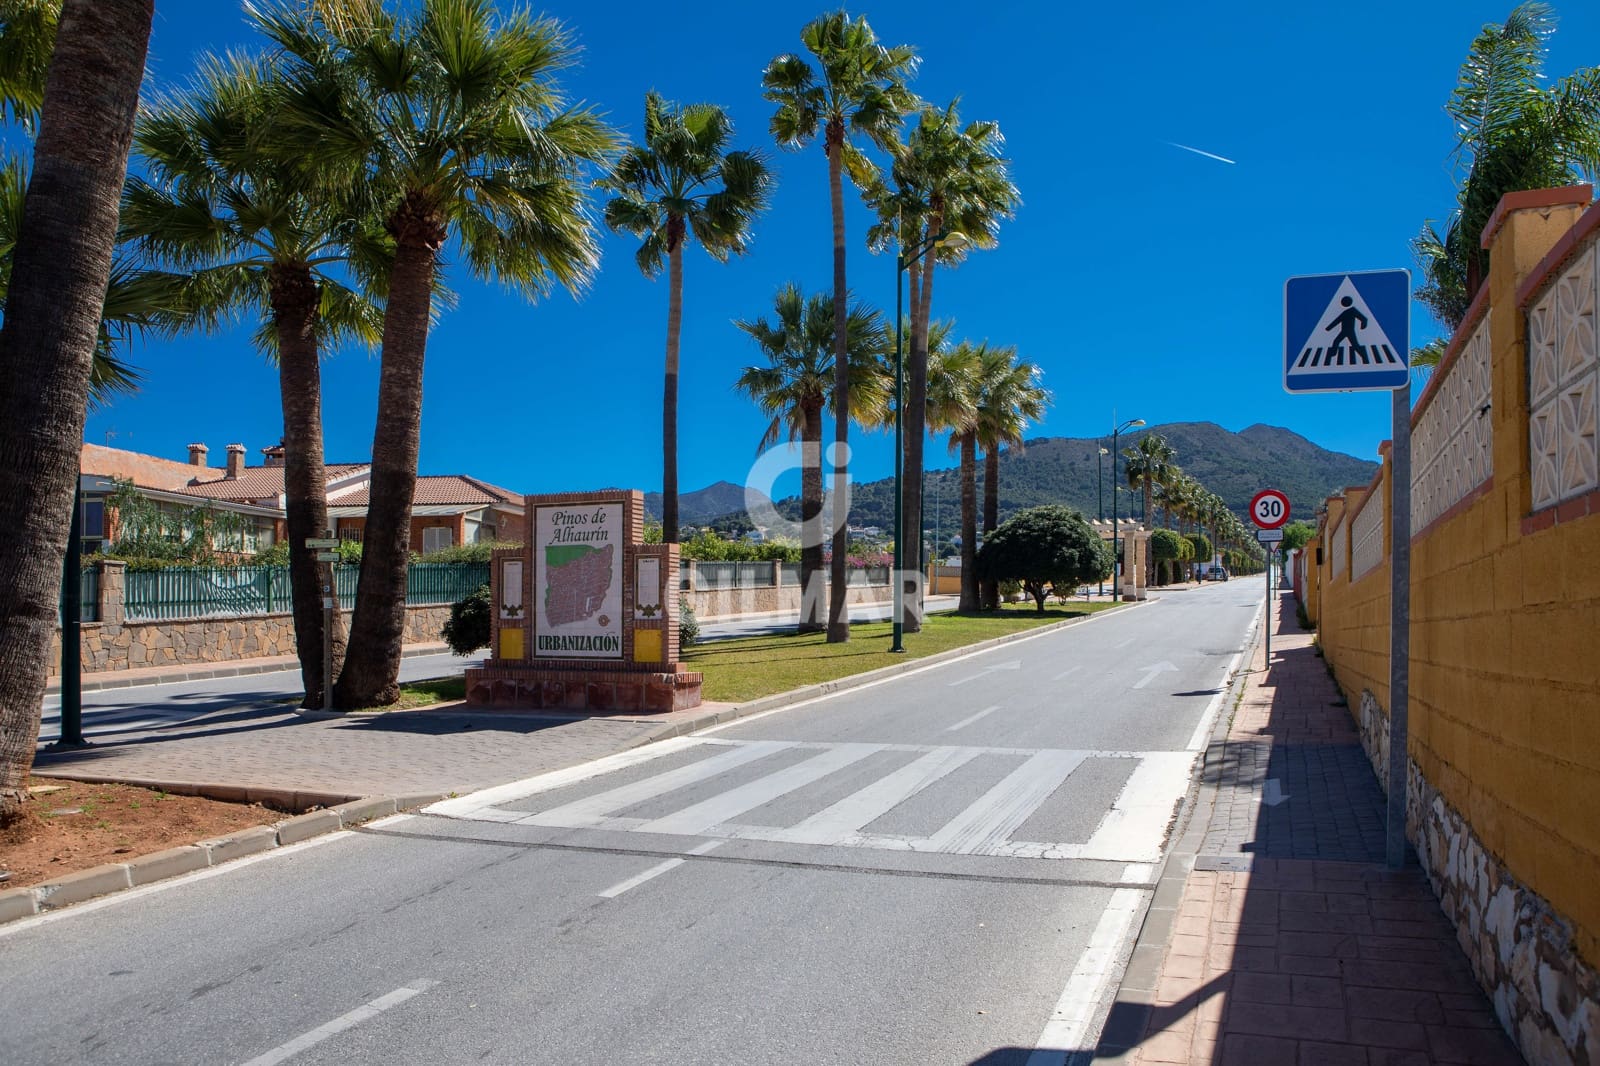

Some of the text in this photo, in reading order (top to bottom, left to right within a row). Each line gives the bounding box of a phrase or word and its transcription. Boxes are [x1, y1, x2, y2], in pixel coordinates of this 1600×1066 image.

[552, 507, 606, 526] Pinos de
[1260, 500, 1281, 518] 30
[549, 526, 609, 545] Alhaurín
